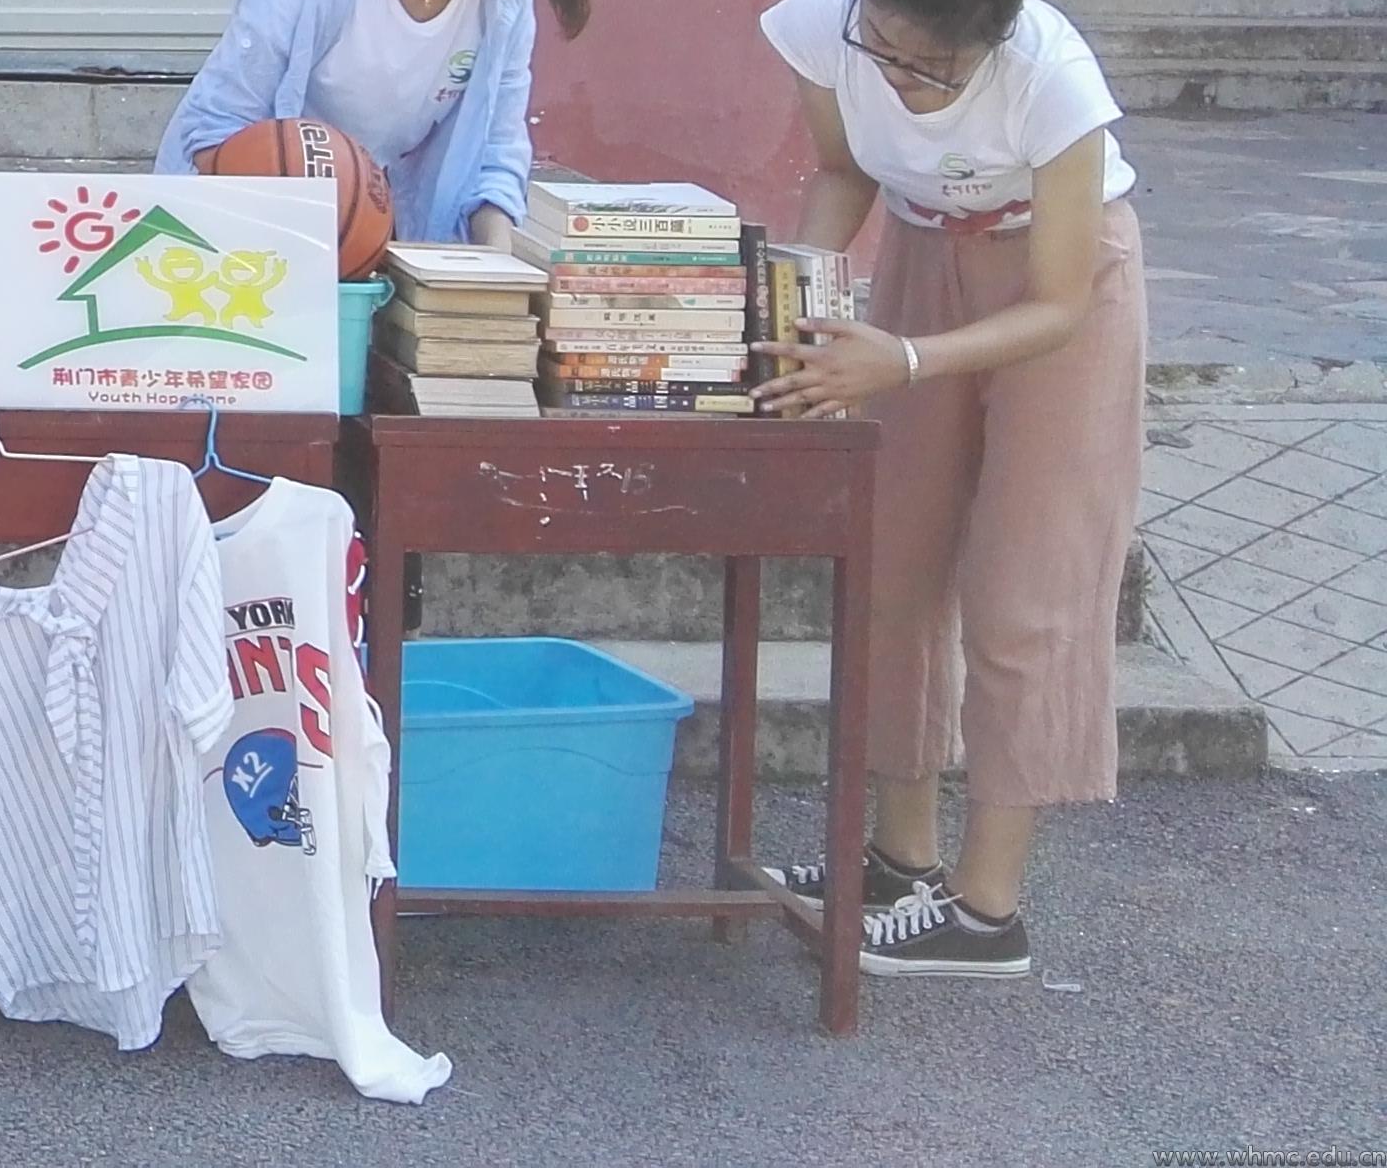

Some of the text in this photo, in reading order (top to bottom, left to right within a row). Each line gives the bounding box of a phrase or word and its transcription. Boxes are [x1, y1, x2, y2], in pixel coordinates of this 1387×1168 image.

[52, 367, 273, 390] 荆门市青少年希望家园
[88, 391, 141, 404] Youth
